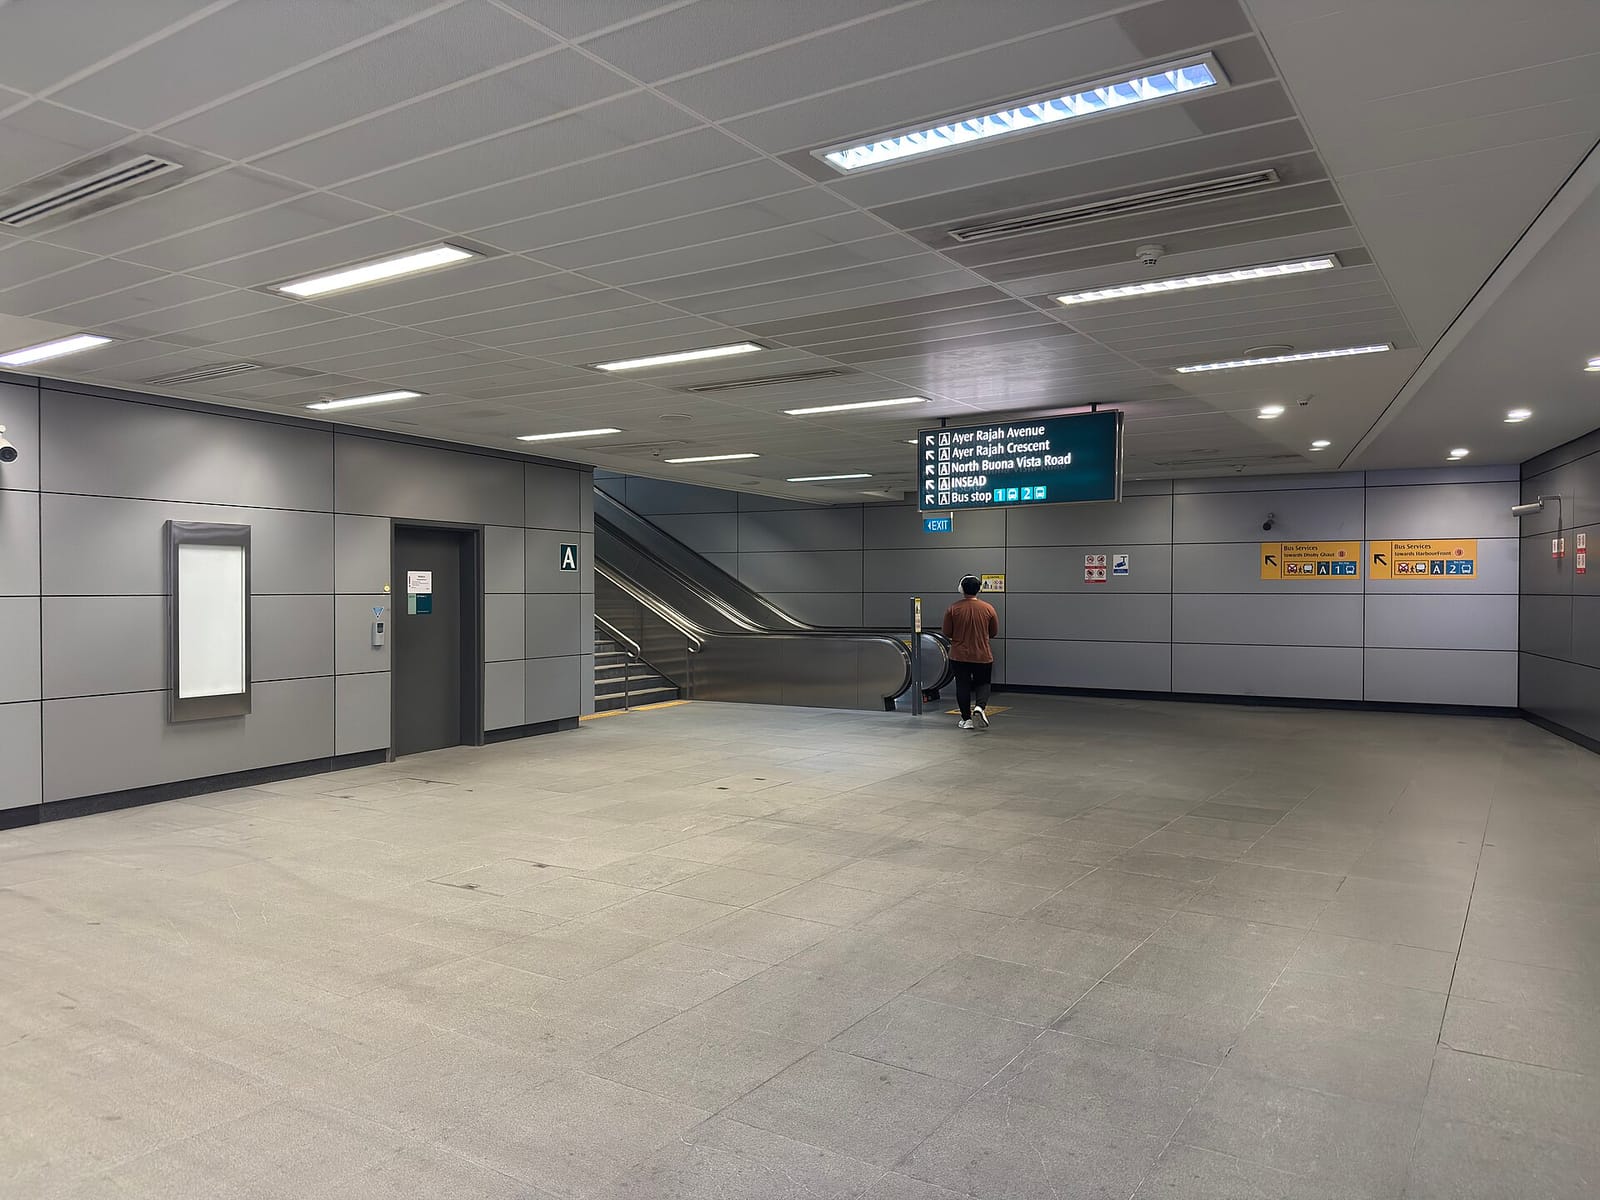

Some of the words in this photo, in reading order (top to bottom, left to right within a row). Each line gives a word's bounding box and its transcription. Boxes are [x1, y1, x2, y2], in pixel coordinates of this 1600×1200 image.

[940, 433, 949, 445] A
[952, 433, 974, 445] Ayer
[976, 428, 1004, 442] Rajah
[1007, 425, 1045, 437] Avenue
[940, 448, 949, 460] A
[952, 447, 974, 459] Ayer
[976, 443, 1004, 457] Rajah
[1007, 439, 1050, 452] Crescent
[940, 463, 949, 475] A
[951, 461, 979, 473] North
[982, 459, 1014, 471] Buona
[1016, 456, 1041, 468] Vista
[1044, 452, 1072, 466] Road
[940, 478, 949, 490] A
[951, 475, 987, 488] INSEAD
[940, 493, 949, 505] A
[951, 492, 969, 503] Bus
[970, 491, 992, 503] stop
[1023, 488, 1031, 500] 2
[931, 520, 949, 531] EXIT
[562, 546, 576, 569] A
[1319, 565, 1327, 574] A
[1432, 565, 1441, 574] A
[1449, 564, 1457, 574] 2
